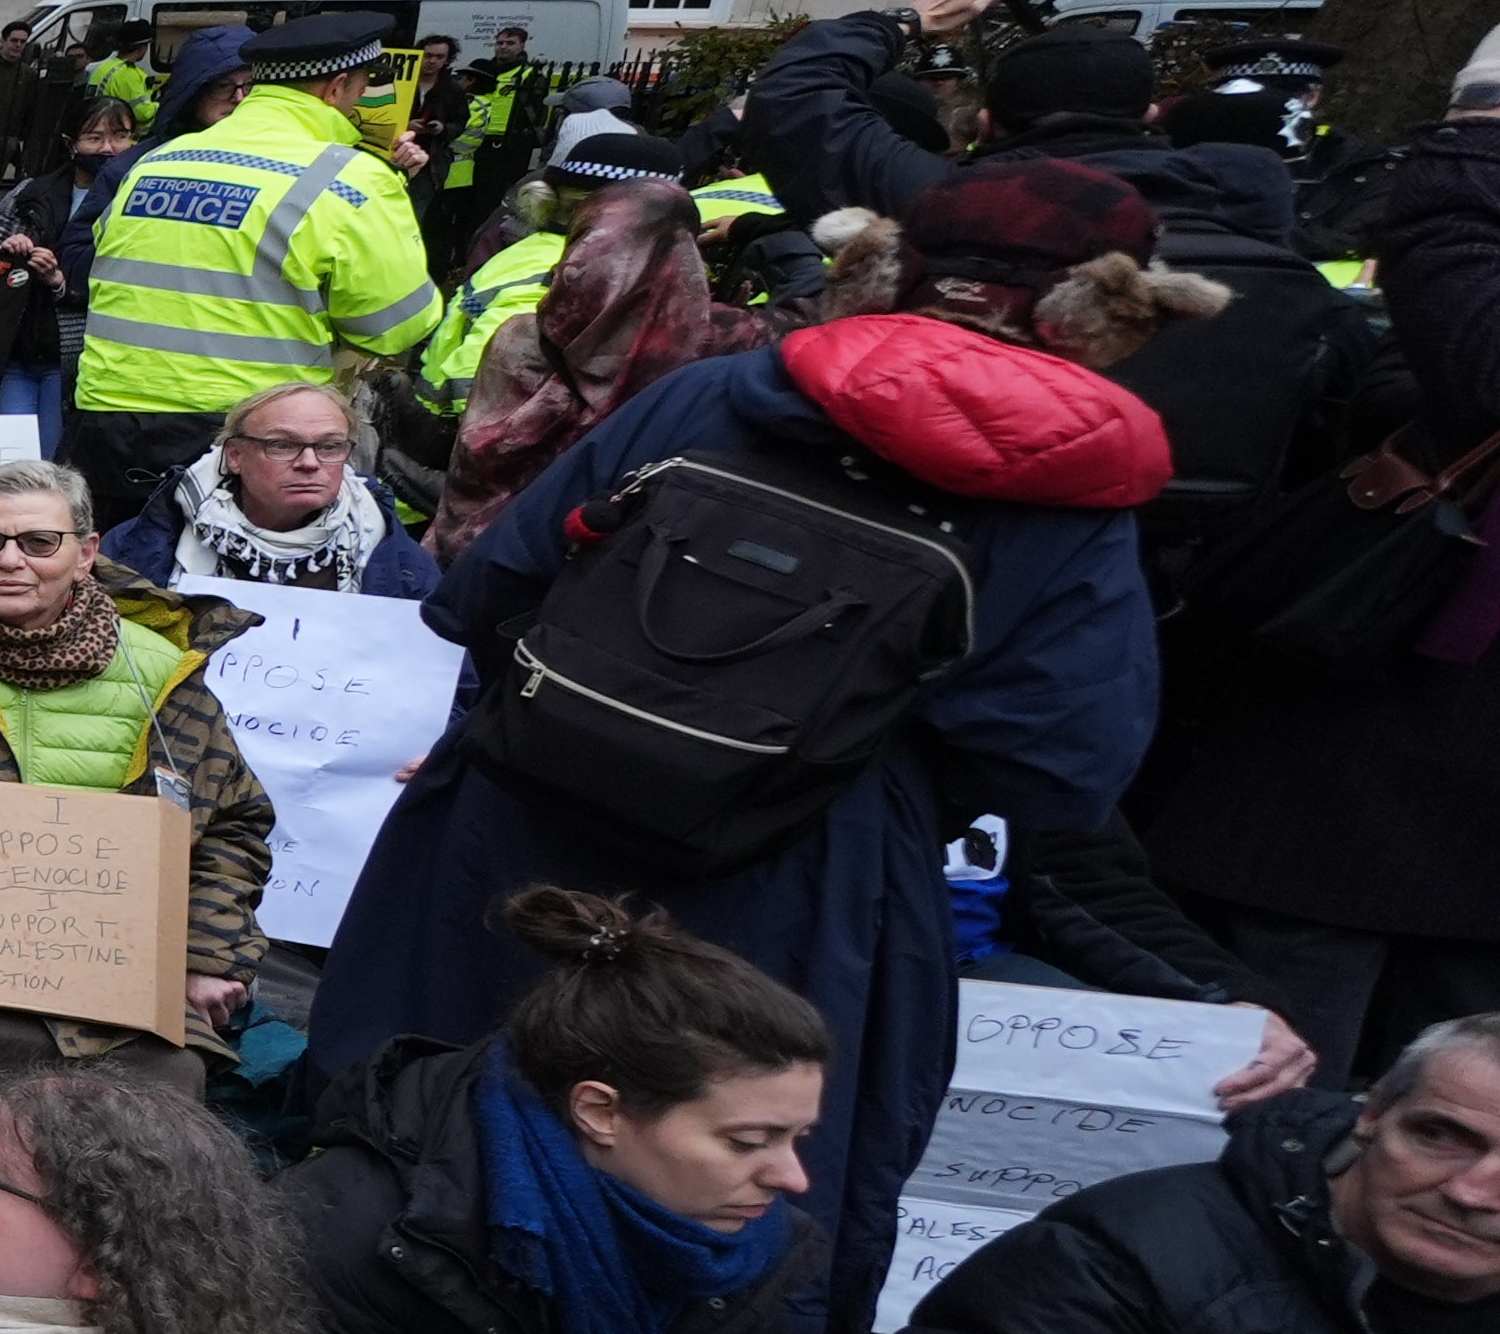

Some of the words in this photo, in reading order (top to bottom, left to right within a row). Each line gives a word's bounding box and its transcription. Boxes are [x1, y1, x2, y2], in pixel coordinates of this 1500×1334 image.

[137, 176, 260, 202] METROPOLITAN
[125, 188, 250, 227] POLICE
[219, 652, 372, 695] PPOSE
[225, 711, 361, 747] NOCIDE
[43, 795, 71, 826] I
[37, 892, 59, 912] I
[966, 1013, 1195, 1060] OPPOSE
[944, 1093, 1159, 1134] NOCIDE
[934, 1162, 1084, 1198] SUPPO
